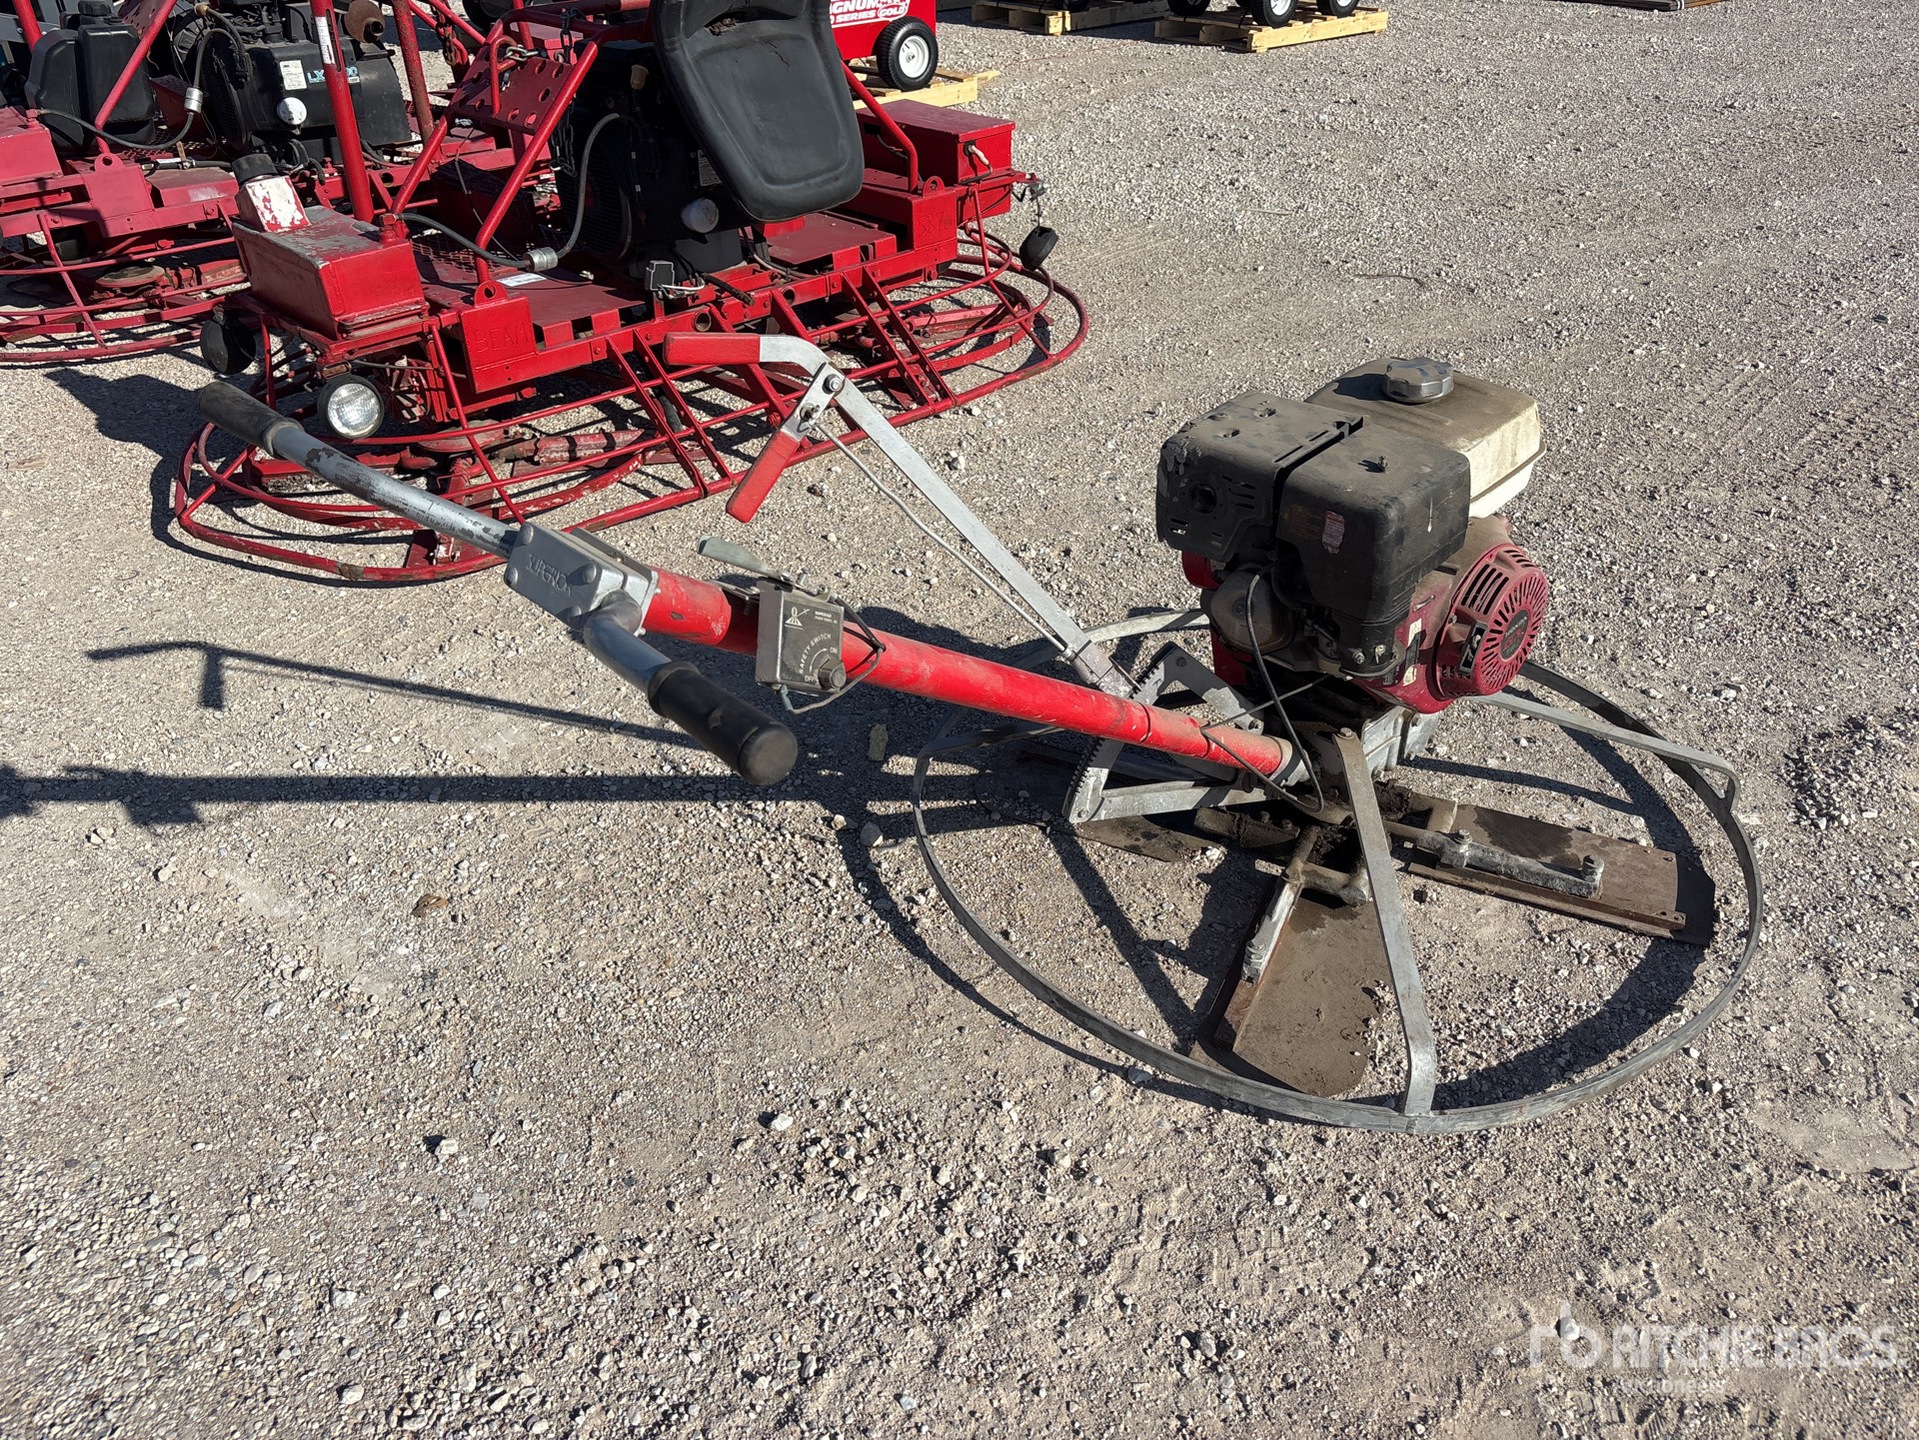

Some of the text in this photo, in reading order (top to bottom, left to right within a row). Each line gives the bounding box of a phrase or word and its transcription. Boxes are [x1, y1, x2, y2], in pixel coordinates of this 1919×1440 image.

[836, 10, 877, 23] SERIES
[879, 6, 905, 17] GOLD
[474, 322, 530, 353] BEAM
[798, 645, 812, 674] SAFETY
[810, 633, 832, 647] SWITCH
